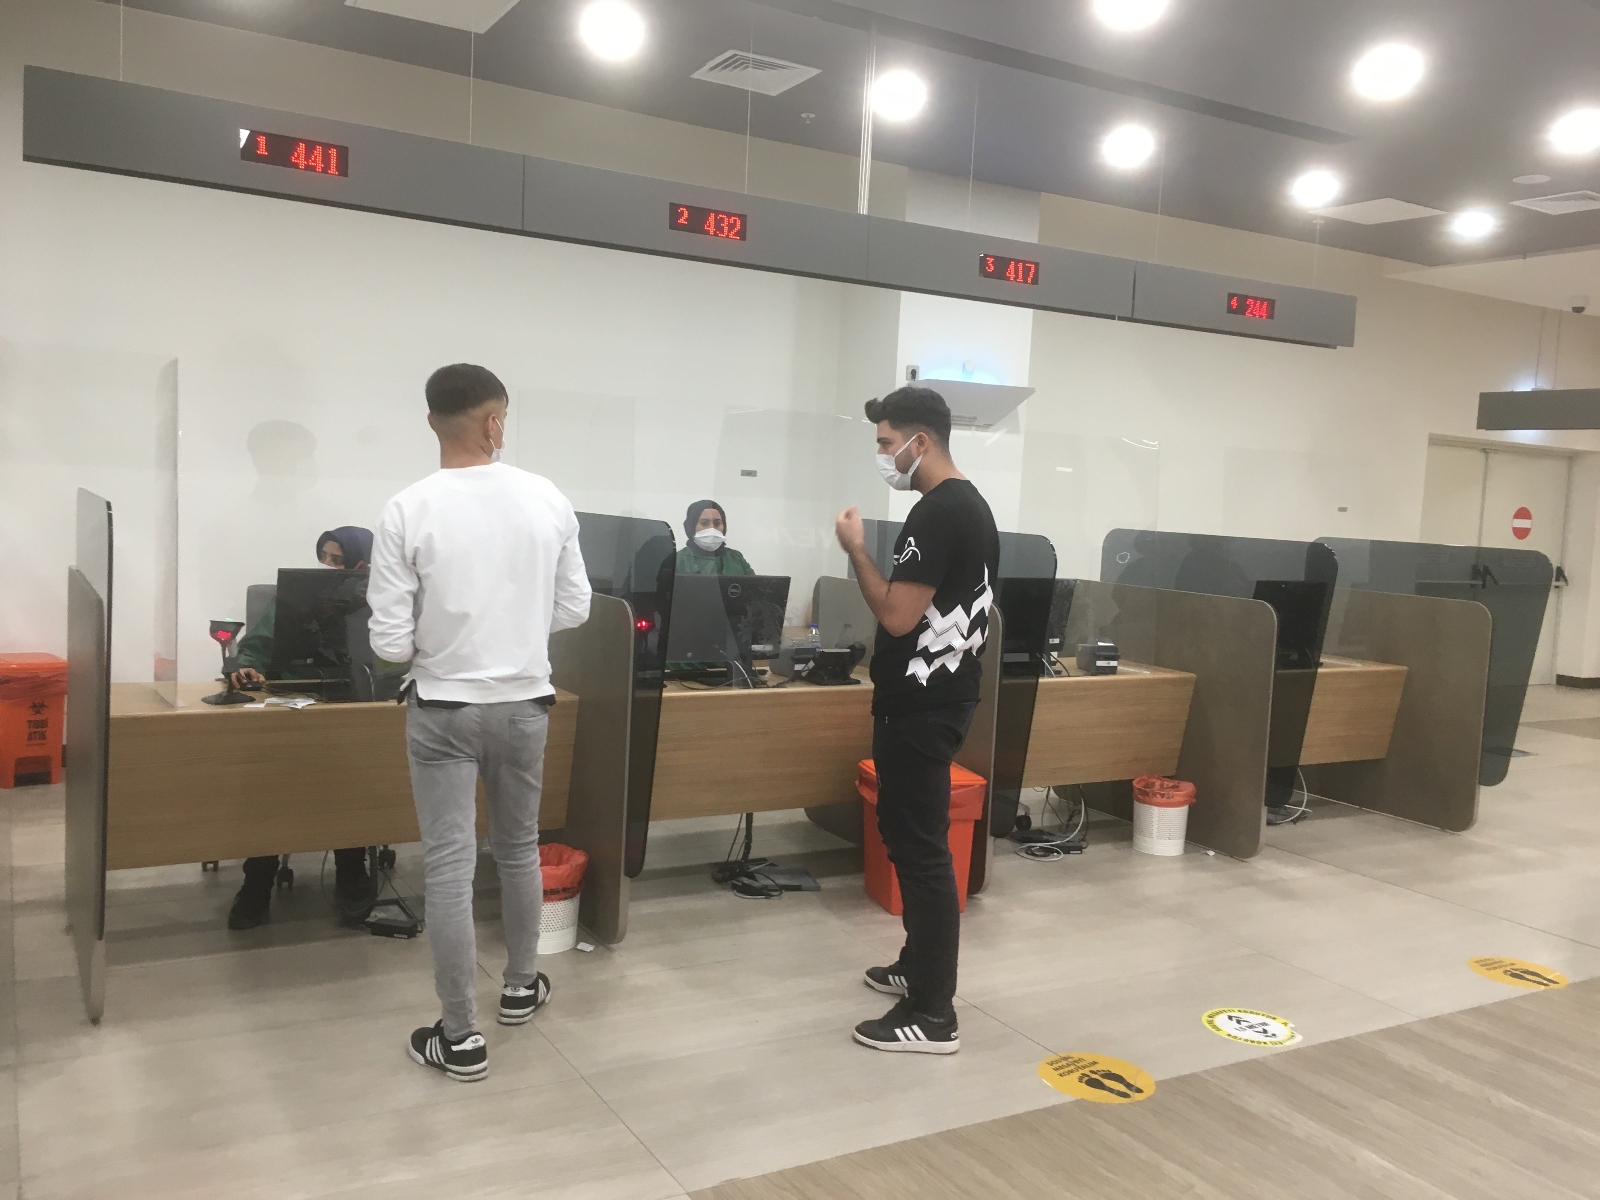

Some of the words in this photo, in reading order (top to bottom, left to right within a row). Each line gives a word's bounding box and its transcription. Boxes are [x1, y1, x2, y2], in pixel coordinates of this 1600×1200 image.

[256, 135, 268, 155] 1
[290, 142, 338, 174] 441
[678, 207, 688, 224] 2
[704, 212, 741, 239] 432
[986, 257, 994, 272] 3
[1006, 261, 1035, 283] 417
[1230, 296, 1238, 309] 4
[1245, 298, 1268, 319] 244
